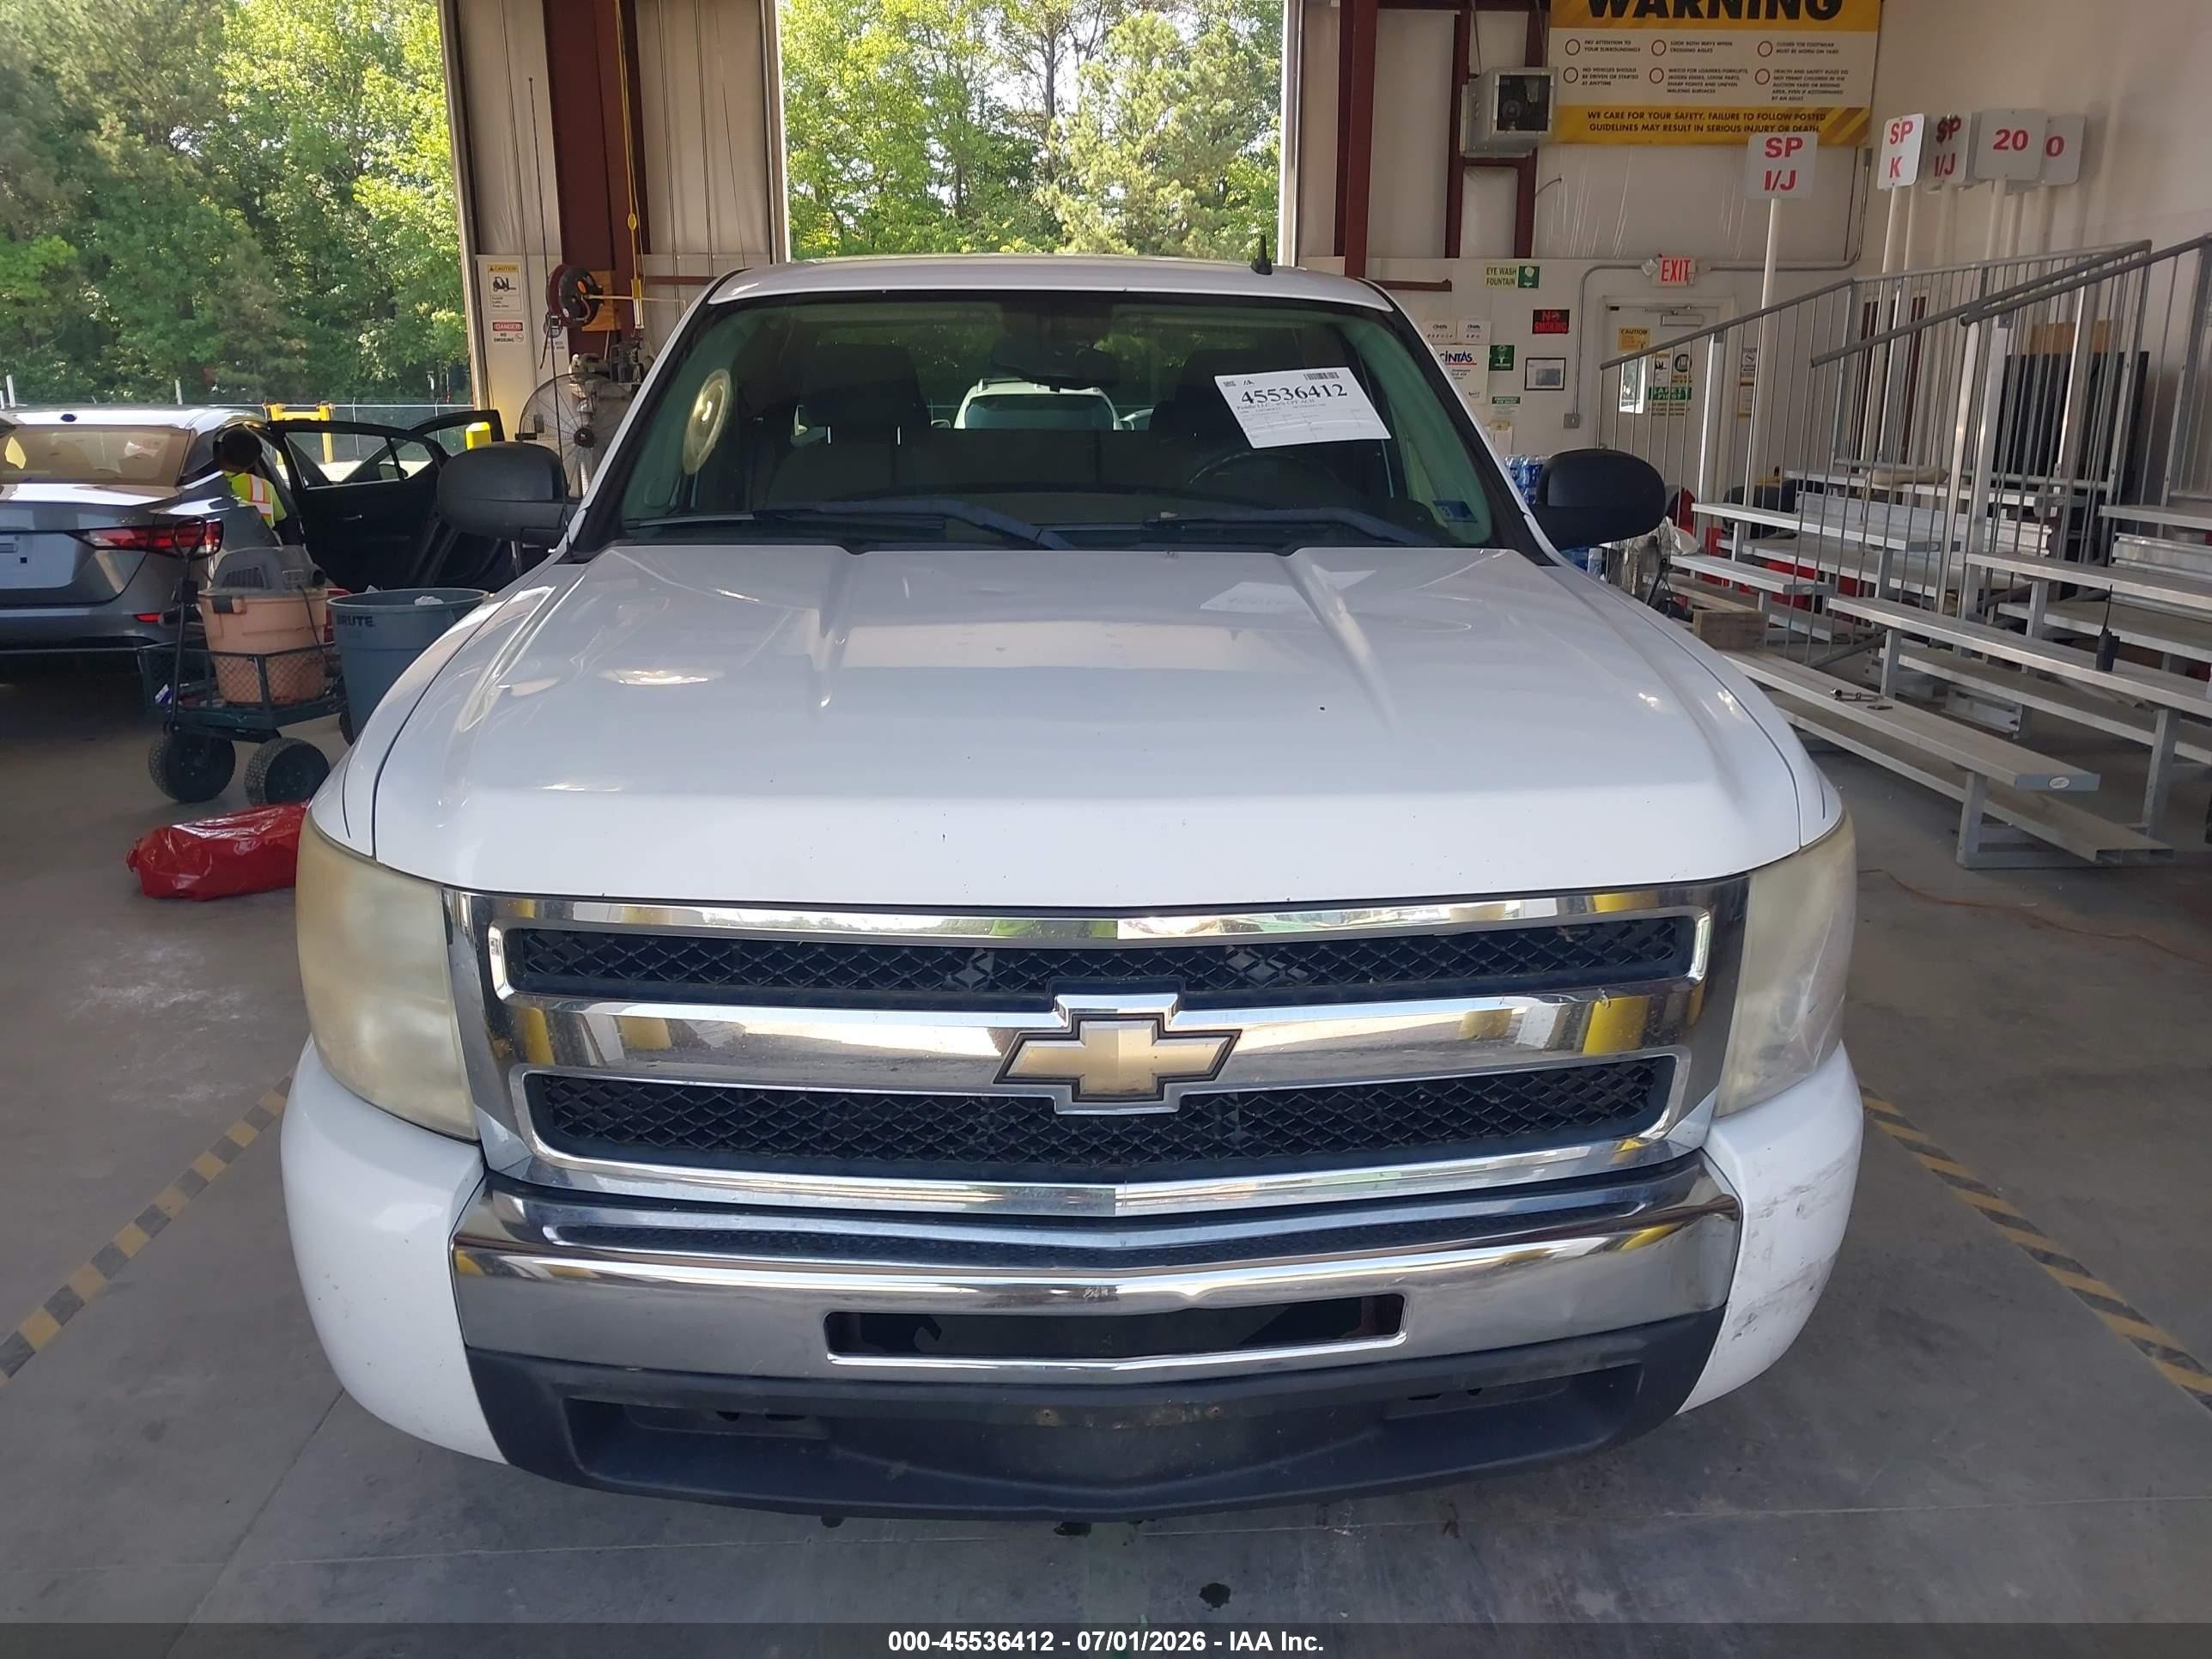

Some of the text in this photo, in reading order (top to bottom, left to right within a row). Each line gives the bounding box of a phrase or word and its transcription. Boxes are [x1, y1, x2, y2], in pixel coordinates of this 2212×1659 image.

[1889, 120, 1913, 144] SP
[1936, 115, 1962, 143] SP
[1993, 129, 2029, 151] 20
[1765, 137, 1803, 158] SP
[1889, 155, 1903, 179] K
[1934, 153, 1956, 178] I/J
[1765, 170, 1796, 191] I/J
[1662, 259, 1691, 283] EXIT
[1534, 322, 1567, 333] SMOKING
[1241, 384, 1347, 404] 45536412
[337, 615, 374, 627] BRUTE
